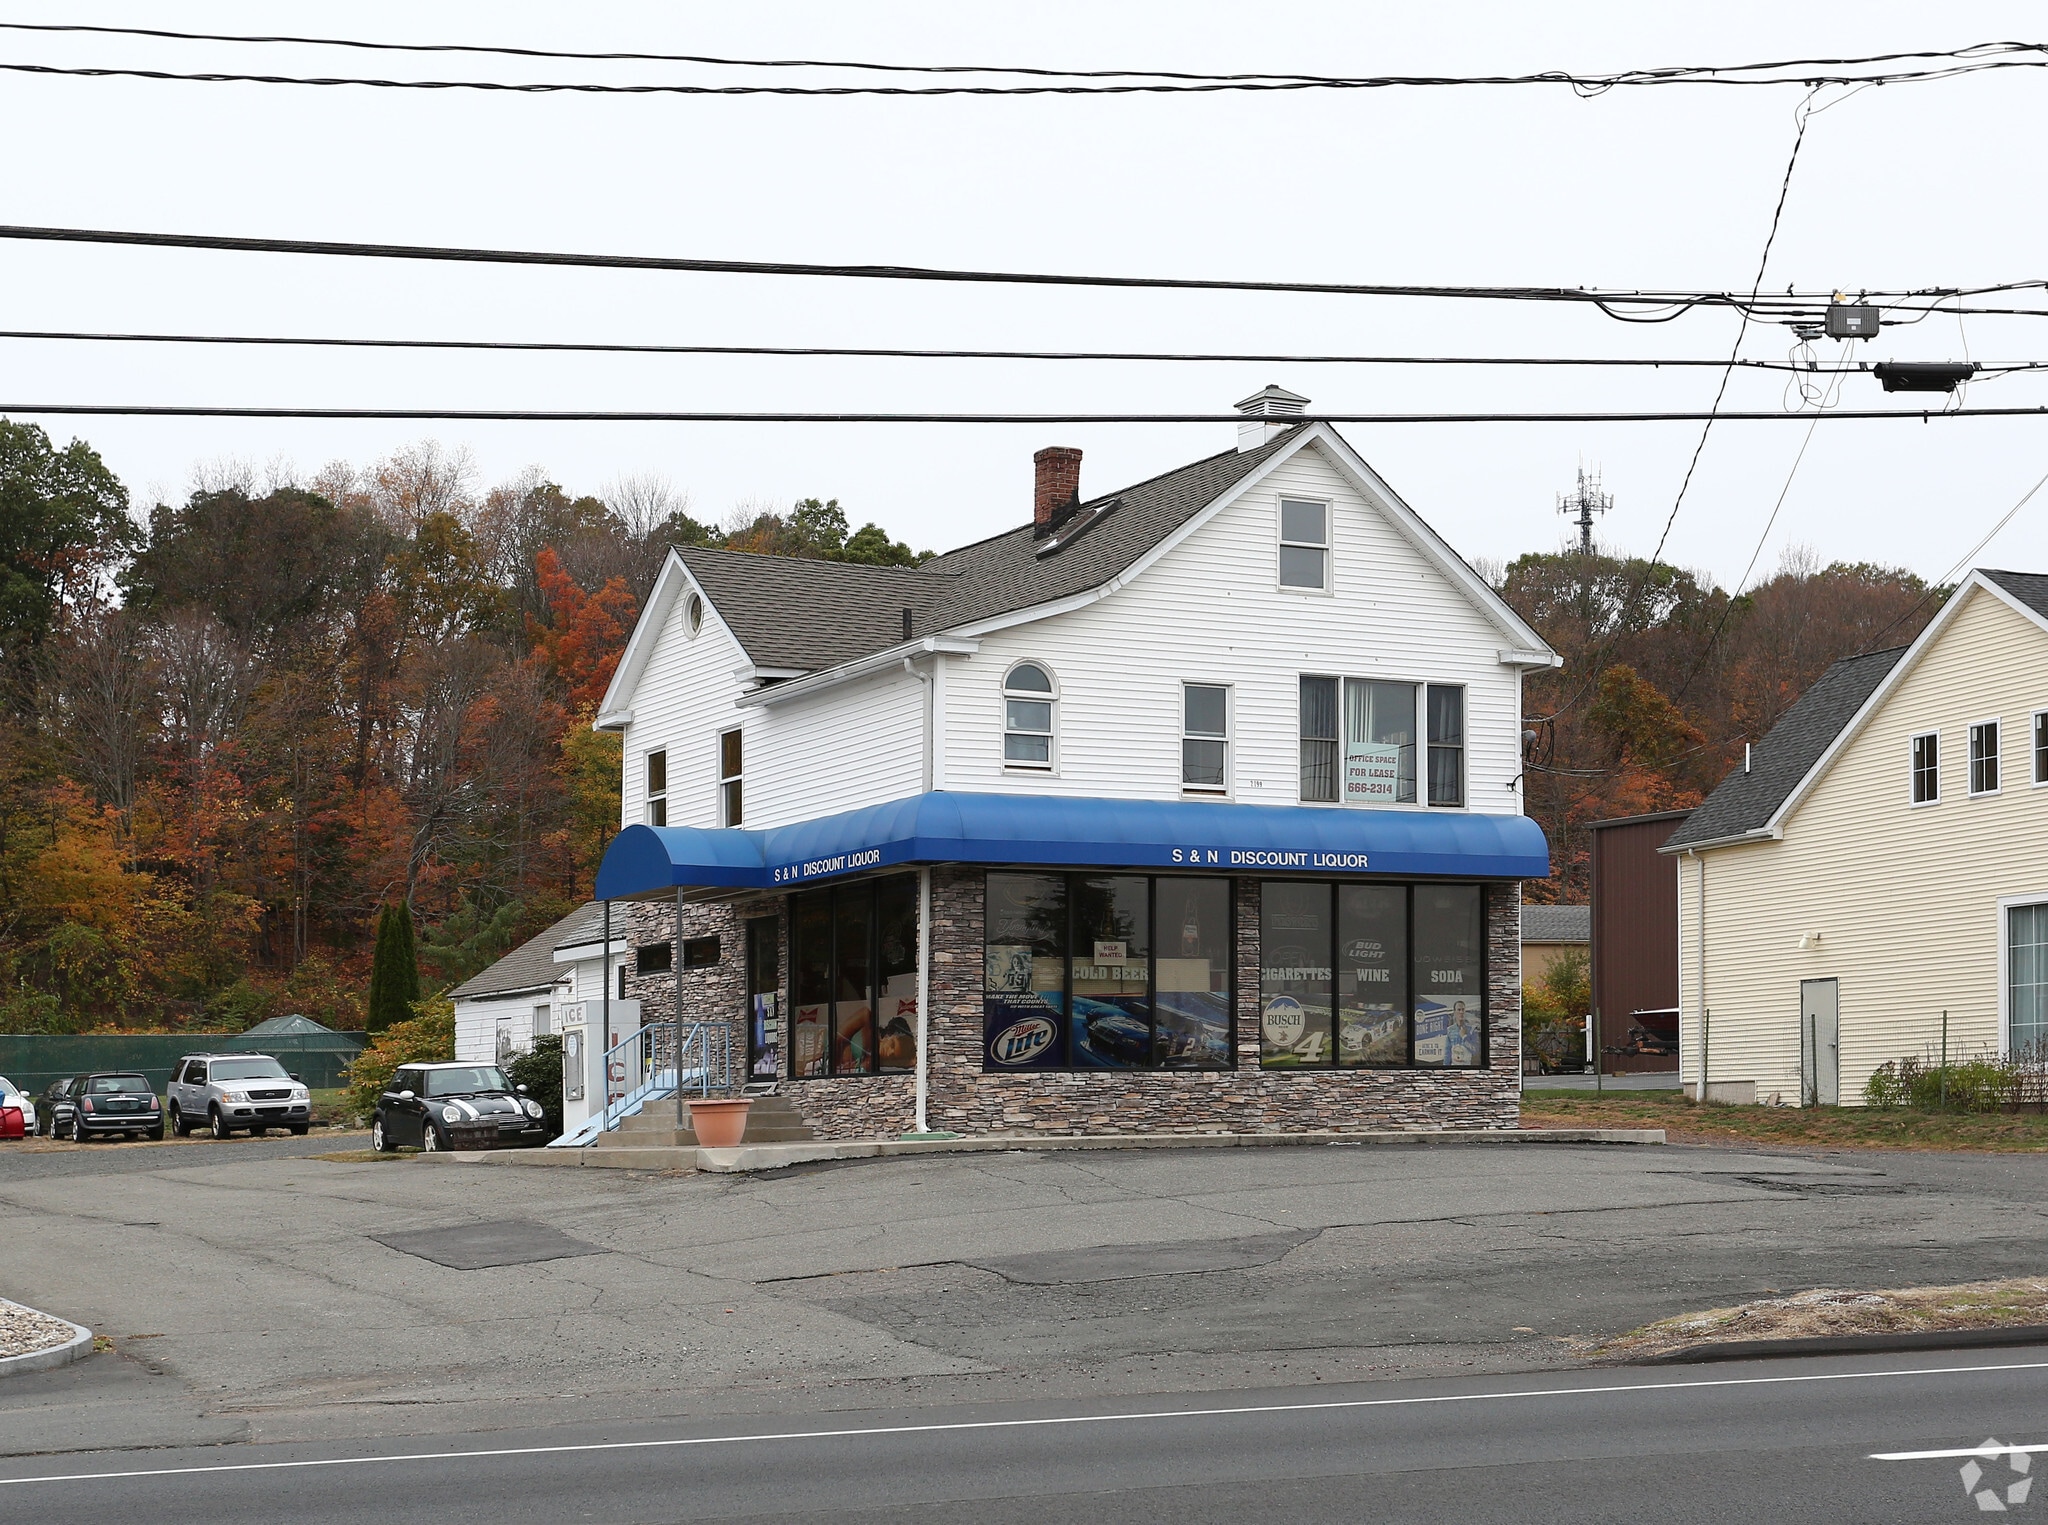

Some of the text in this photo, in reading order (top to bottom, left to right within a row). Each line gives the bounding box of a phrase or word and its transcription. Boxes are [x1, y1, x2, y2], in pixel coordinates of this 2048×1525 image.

[1349, 755, 1396, 764] OFFICE SPACE
[1349, 768, 1395, 778] FOR LEASE
[1348, 782, 1392, 794] 666-2314
[1172, 848, 1368, 868] S & N DISCOUNT LIQUOR
[774, 849, 880, 882] S & N DISCOUNT LIQUOR
[1355, 941, 1382, 950] BUD
[1348, 949, 1386, 958] LIGHT
[1072, 966, 1149, 980] COLD BEER
[1261, 967, 1332, 981] CIGARETTES
[1356, 968, 1390, 982] WINE
[1431, 970, 1463, 983] SODA
[565, 1006, 583, 1023] ICE
[1267, 1014, 1301, 1026] BUSCH
[1011, 1023, 1041, 1036] Miller
[1004, 1029, 1048, 1061] Lite
[1181, 1037, 1196, 1057] 2
[1292, 1031, 1325, 1064] 4
